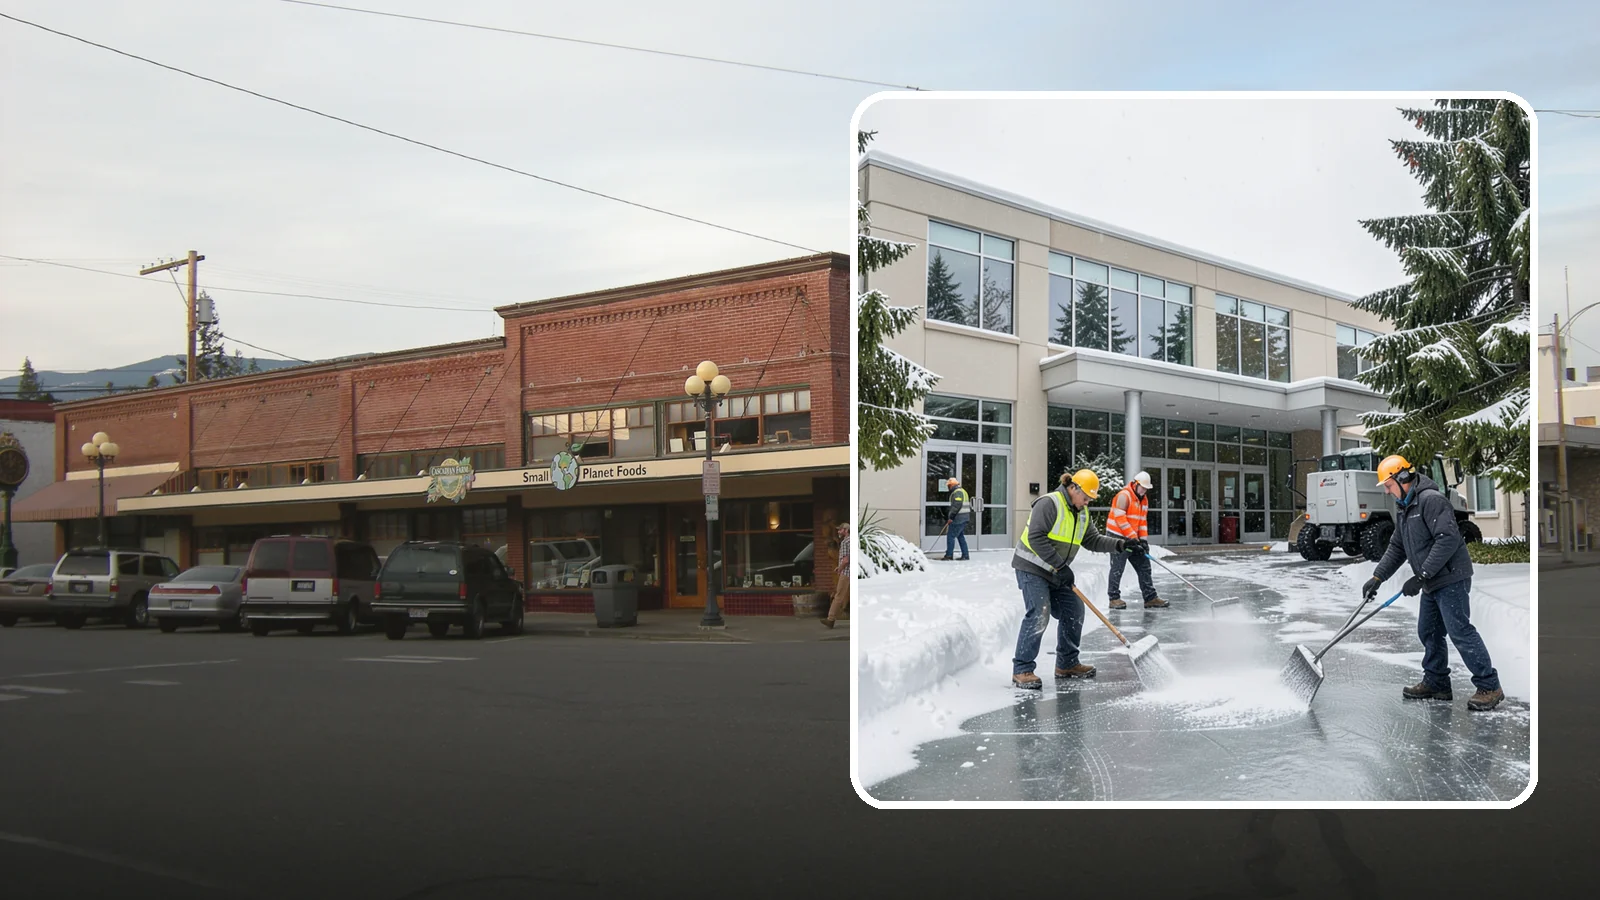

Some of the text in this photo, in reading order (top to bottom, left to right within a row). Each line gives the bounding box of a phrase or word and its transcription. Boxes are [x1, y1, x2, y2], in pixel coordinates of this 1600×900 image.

[523, 464, 647, 483] Small Planet Foods
